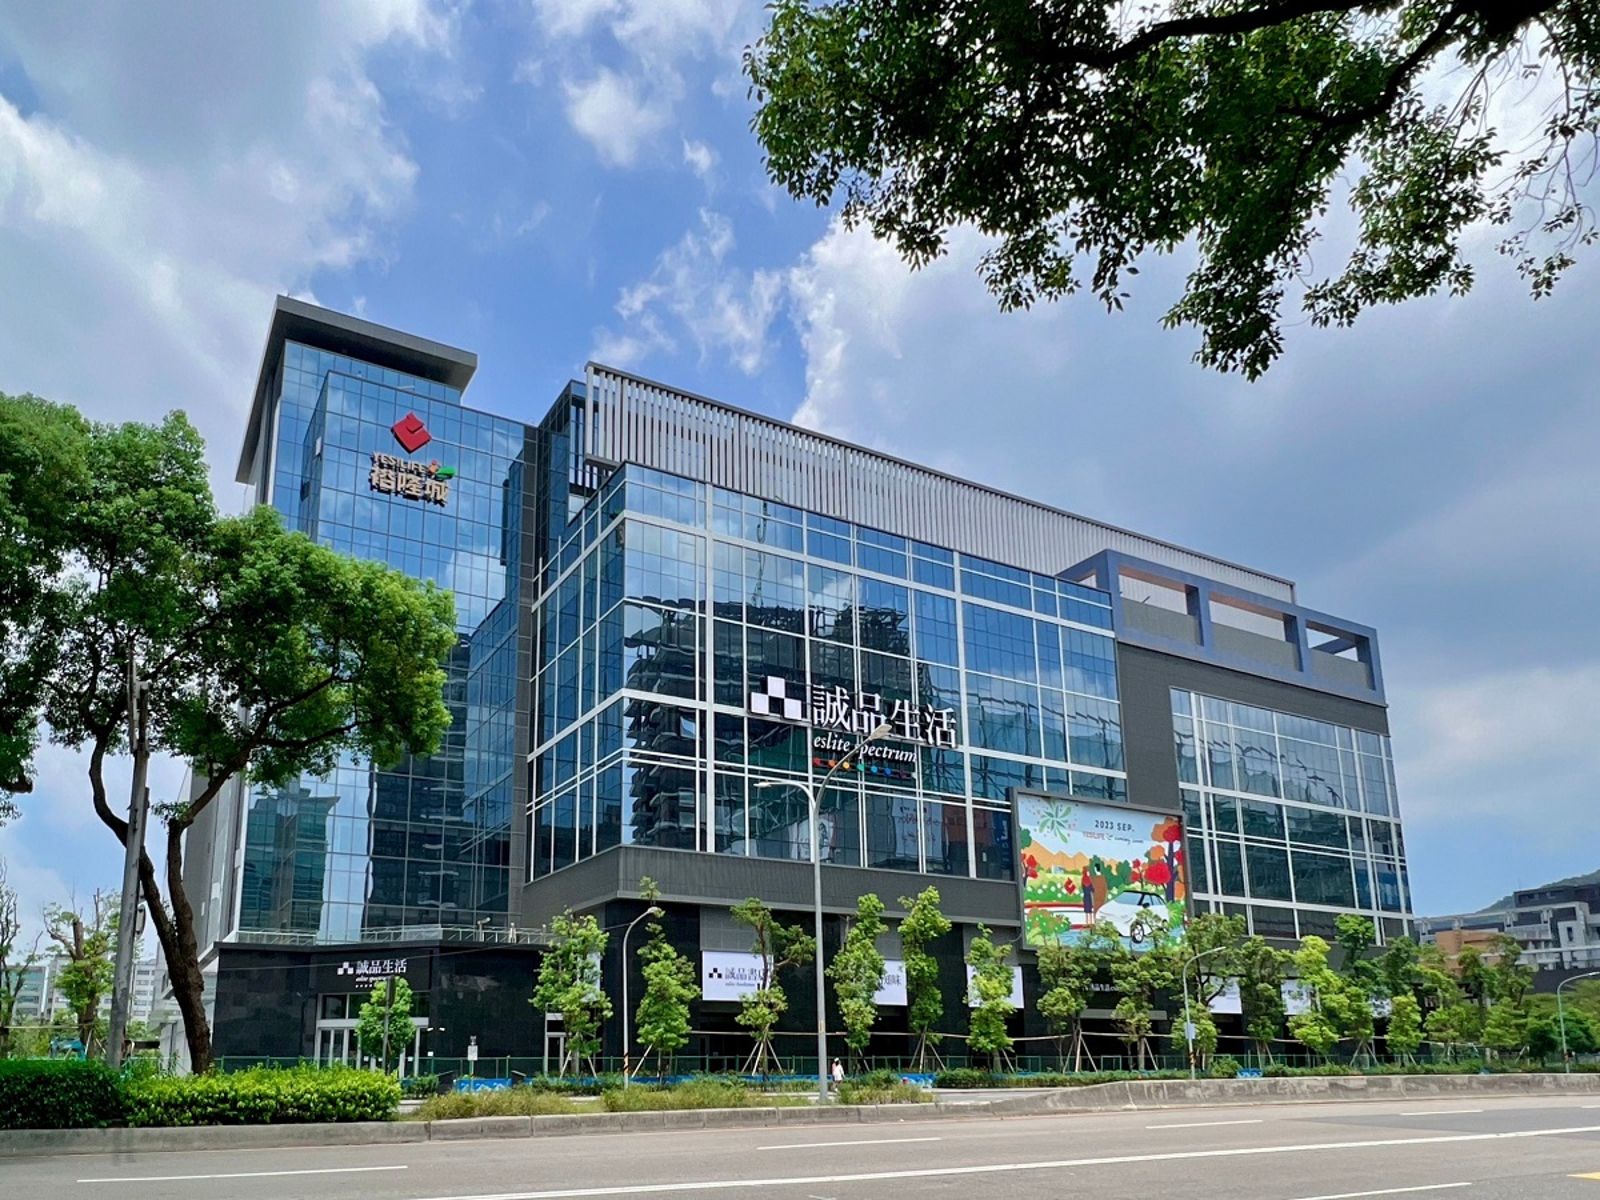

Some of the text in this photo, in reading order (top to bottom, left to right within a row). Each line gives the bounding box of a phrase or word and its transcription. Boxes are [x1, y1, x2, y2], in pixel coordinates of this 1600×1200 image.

[371, 467, 448, 504] 裕隆城
[812, 684, 956, 748] 誠品生活
[813, 731, 850, 752] eslite
[1094, 819, 1114, 830] 2023
[356, 959, 407, 974] 誠品生活
